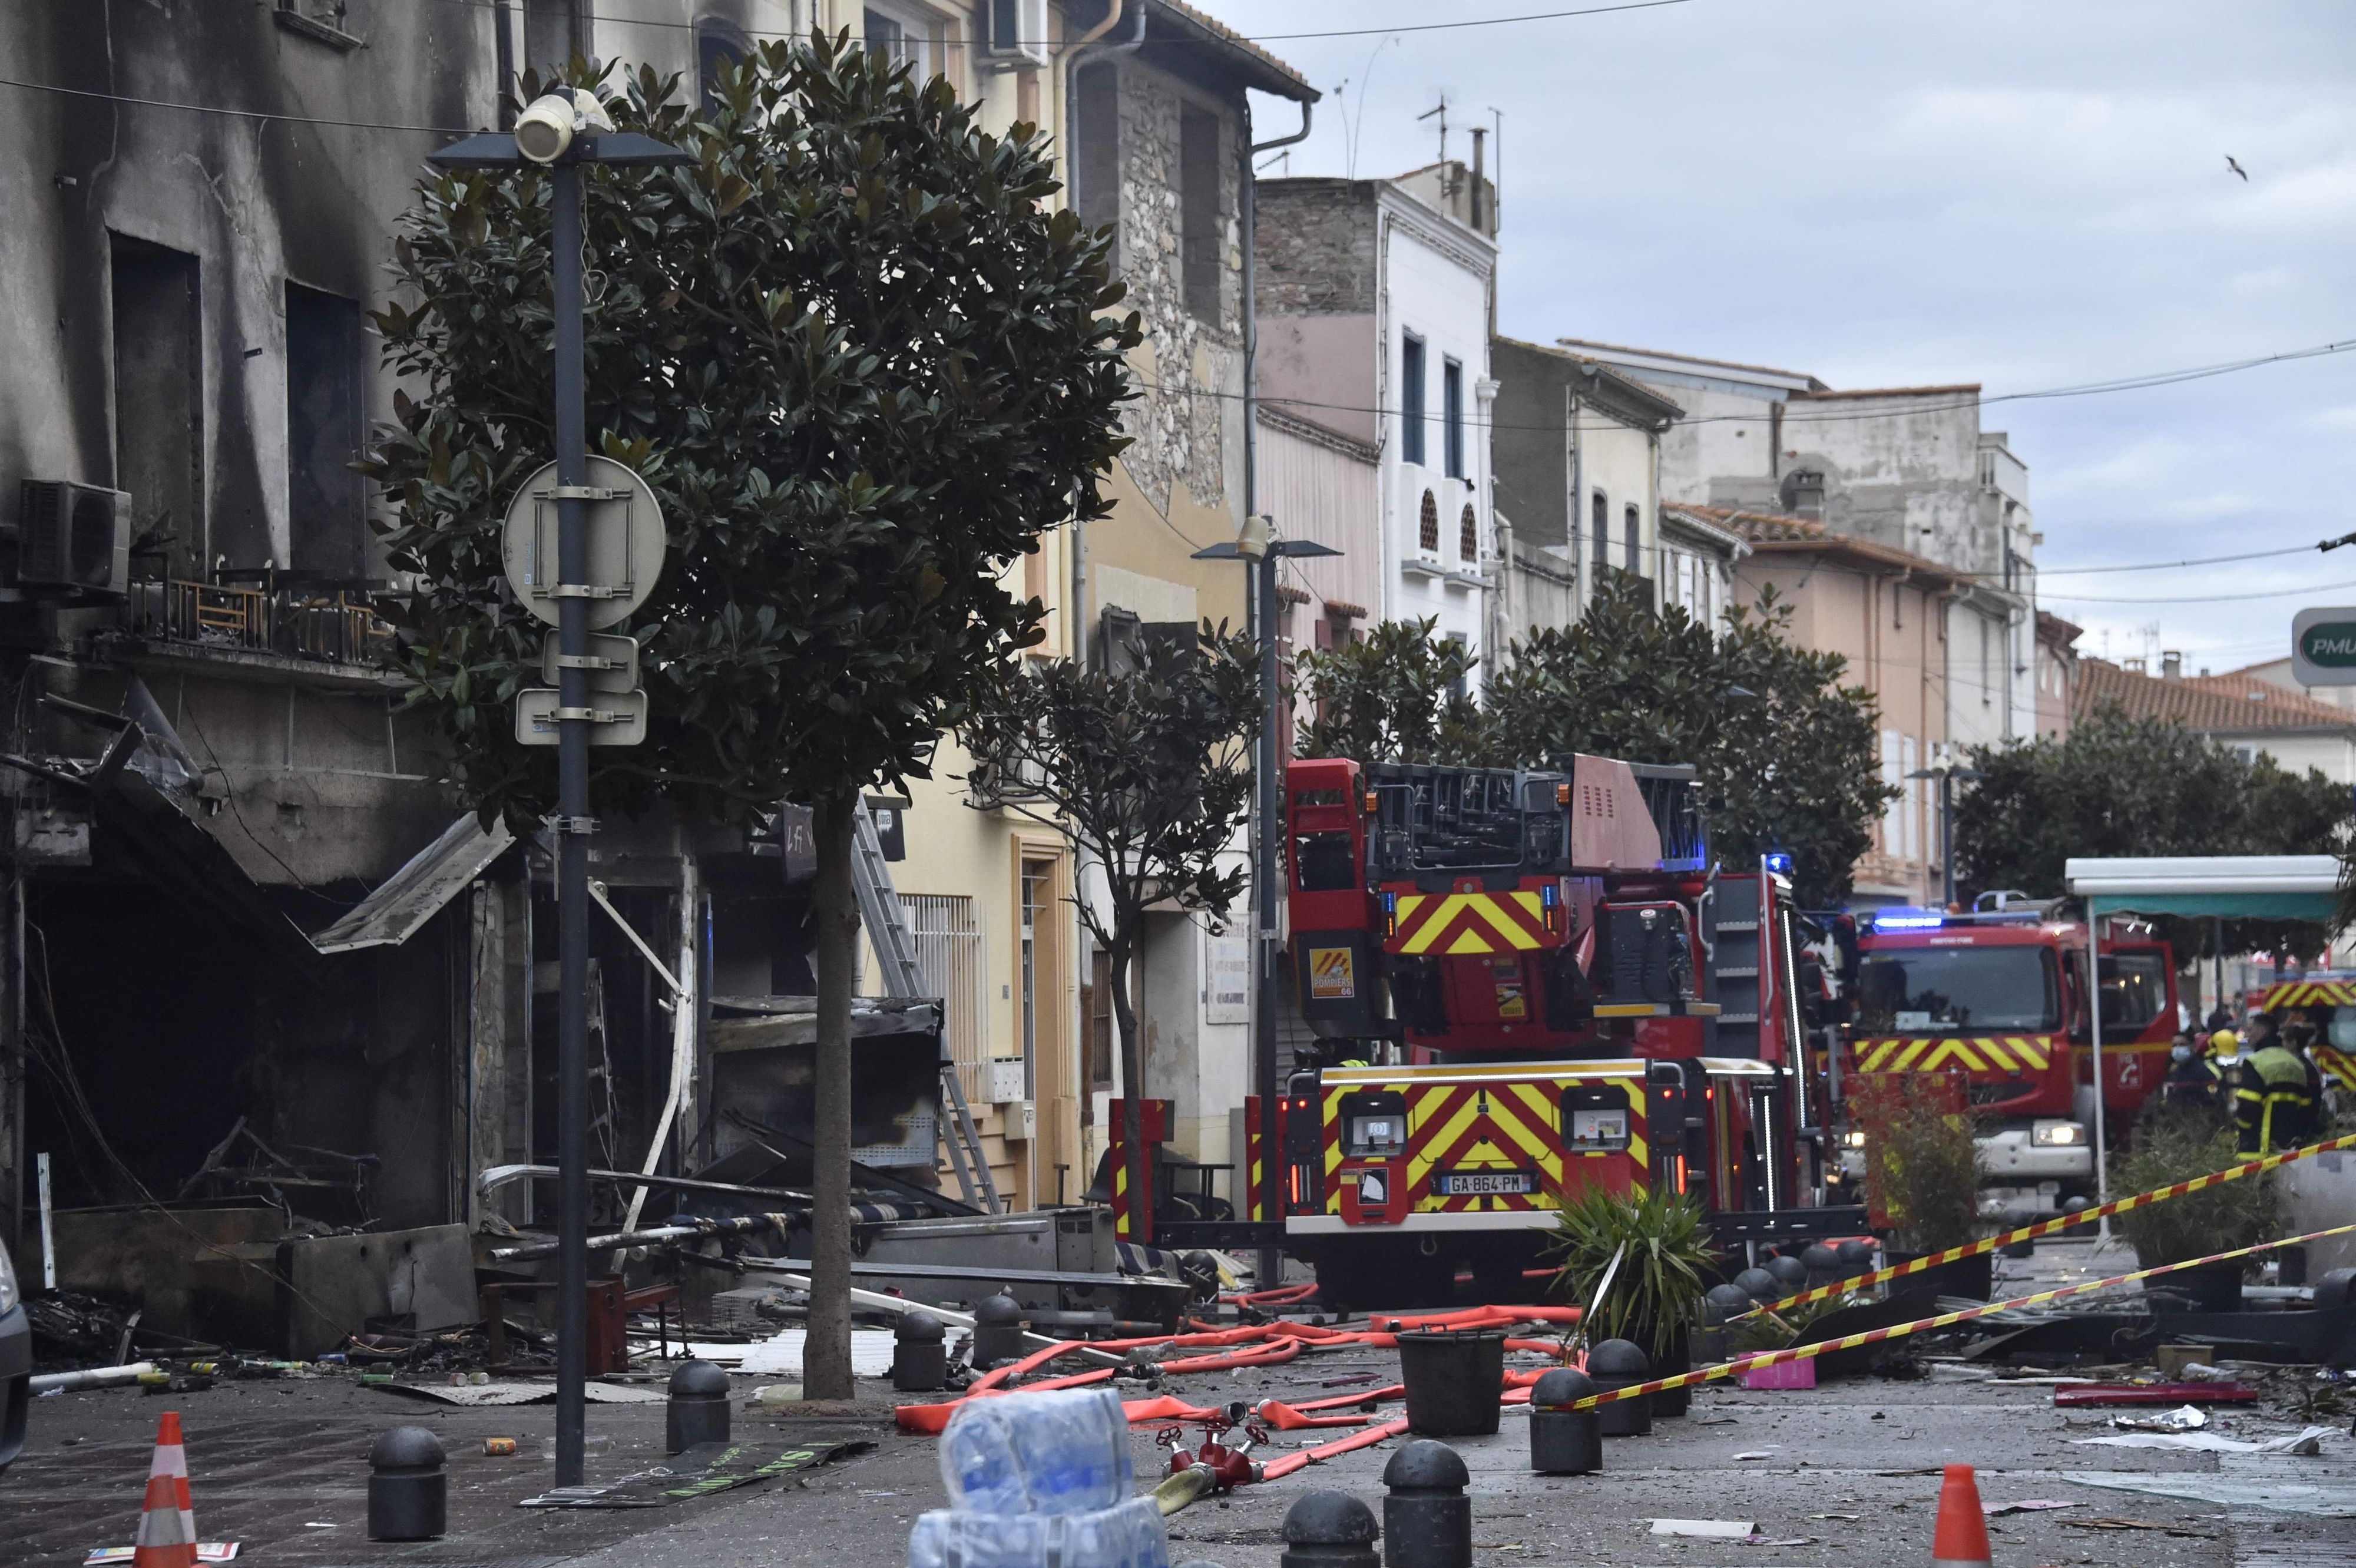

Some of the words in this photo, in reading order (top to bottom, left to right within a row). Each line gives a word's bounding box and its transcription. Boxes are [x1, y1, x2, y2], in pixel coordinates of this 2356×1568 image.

[2312, 638, 2356, 655] PMU
[1314, 978, 1350, 987] POMPIERS
[1341, 987, 1352, 995] 66
[1452, 1177, 1520, 1192] GA-864-PM
